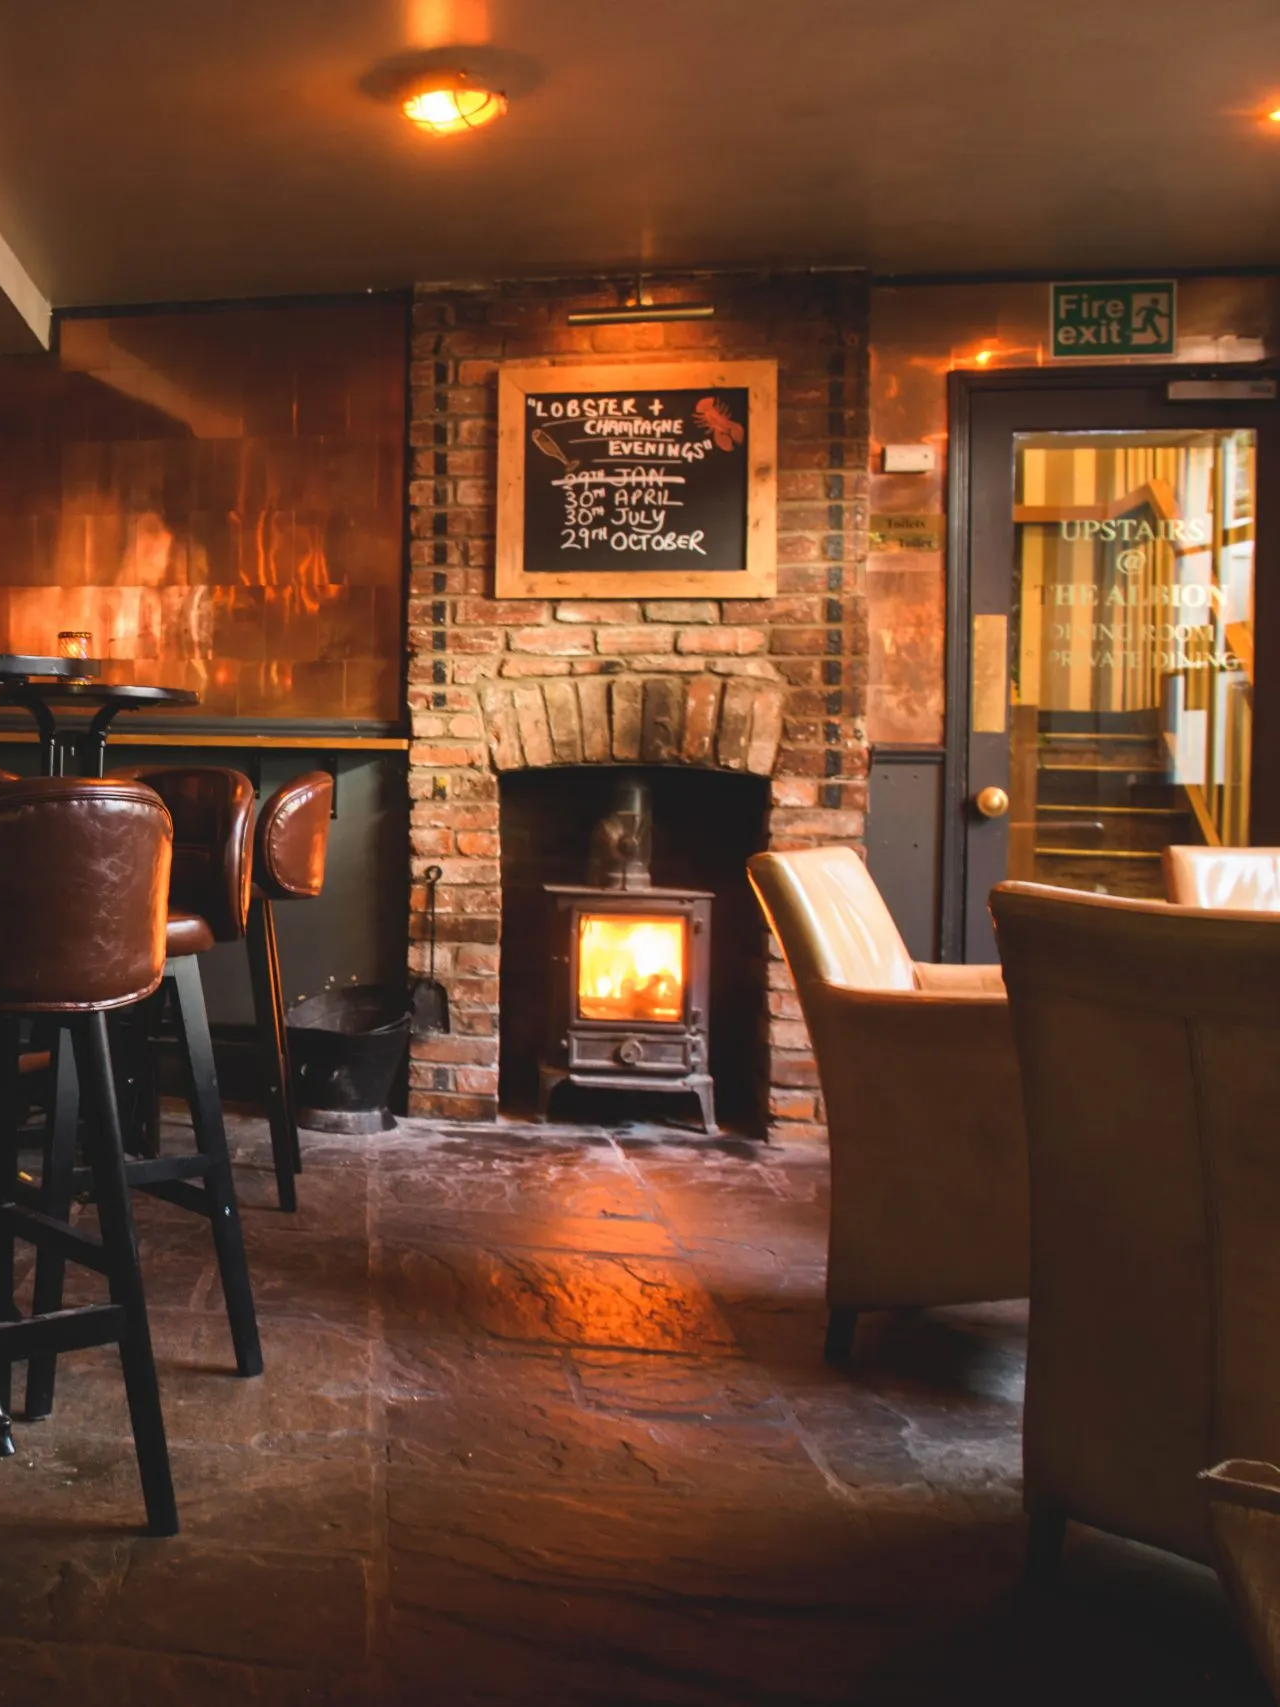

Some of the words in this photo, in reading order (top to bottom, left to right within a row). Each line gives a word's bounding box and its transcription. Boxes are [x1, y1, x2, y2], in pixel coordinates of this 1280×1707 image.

[1059, 294, 1125, 318] Fire
[1057, 320, 1122, 345] exit
[584, 419, 684, 437] CHAMPAGNE
[614, 489, 684, 506] APRIL
[611, 508, 666, 534] JULY
[1060, 519, 1205, 541] UPSTAIRS
[560, 527, 608, 550] 29TH
[610, 530, 707, 555] OCTOBER
[1115, 549, 1147, 575] @
[1034, 584, 1098, 607] THE
[1105, 584, 1230, 607] ALBION
[1050, 623, 1133, 642] DINING
[1143, 623, 1214, 642] ROOM
[1049, 650, 1142, 668] PRIVATE
[1153, 651, 1240, 670] DINING
